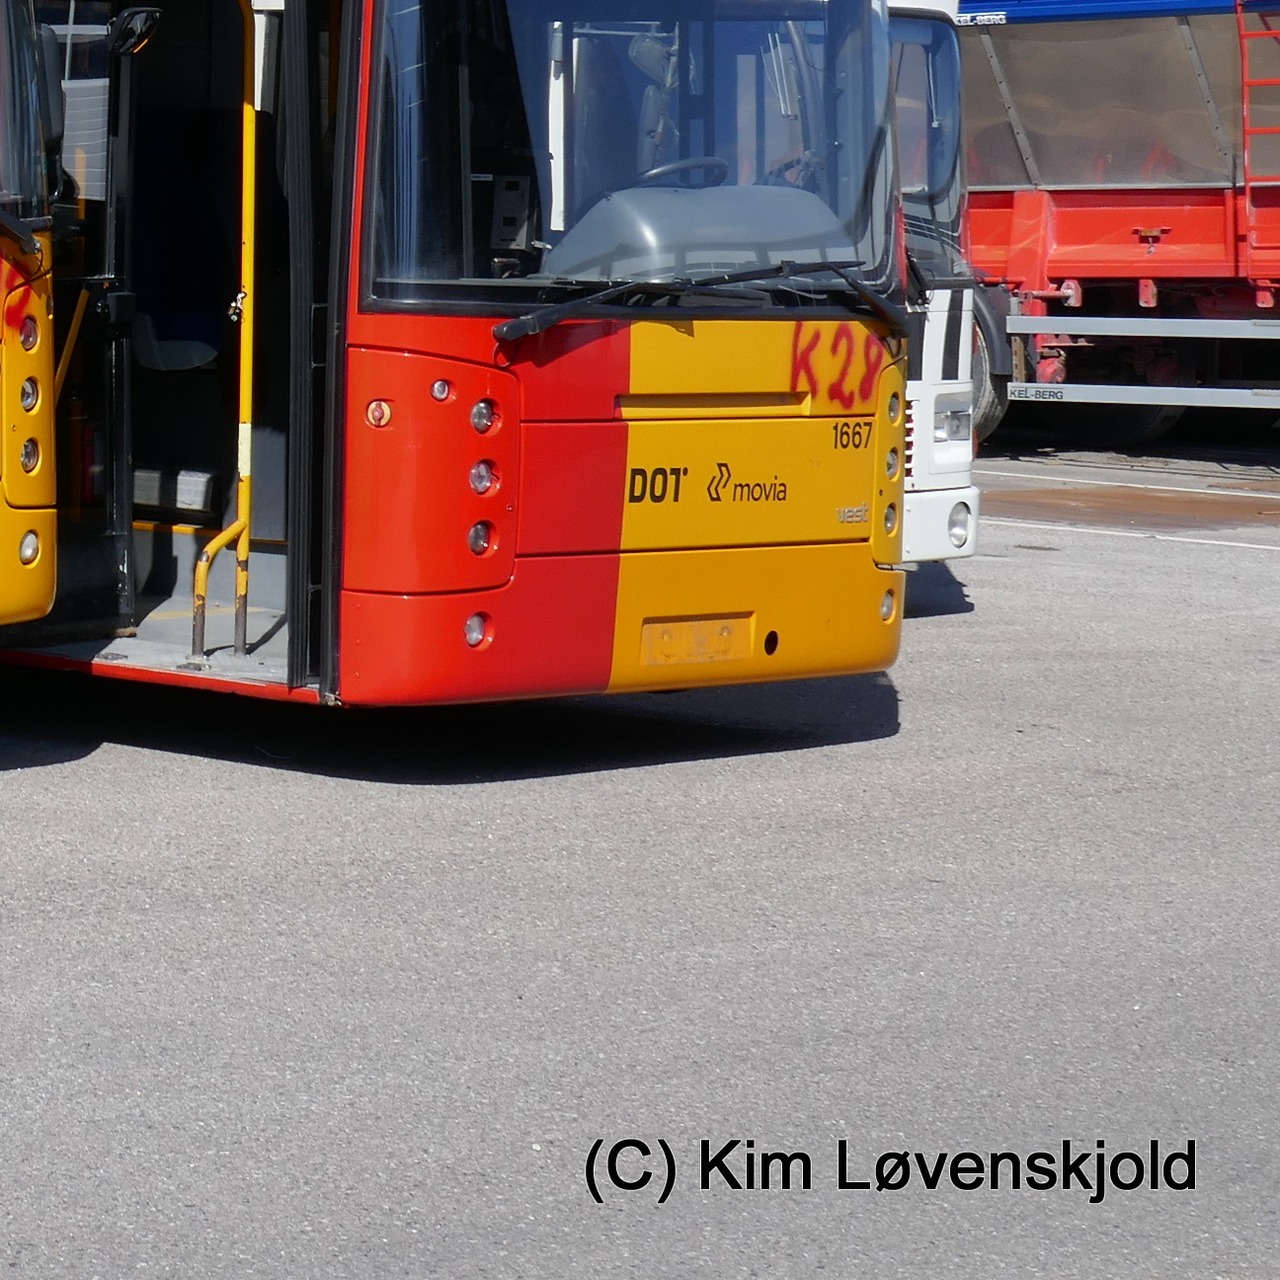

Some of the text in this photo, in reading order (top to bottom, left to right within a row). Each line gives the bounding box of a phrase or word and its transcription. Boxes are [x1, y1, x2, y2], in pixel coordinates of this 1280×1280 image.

[1009, 387, 1064, 400] KEL-BERG
[833, 422, 873, 449] 1667
[733, 475, 787, 501] movia
